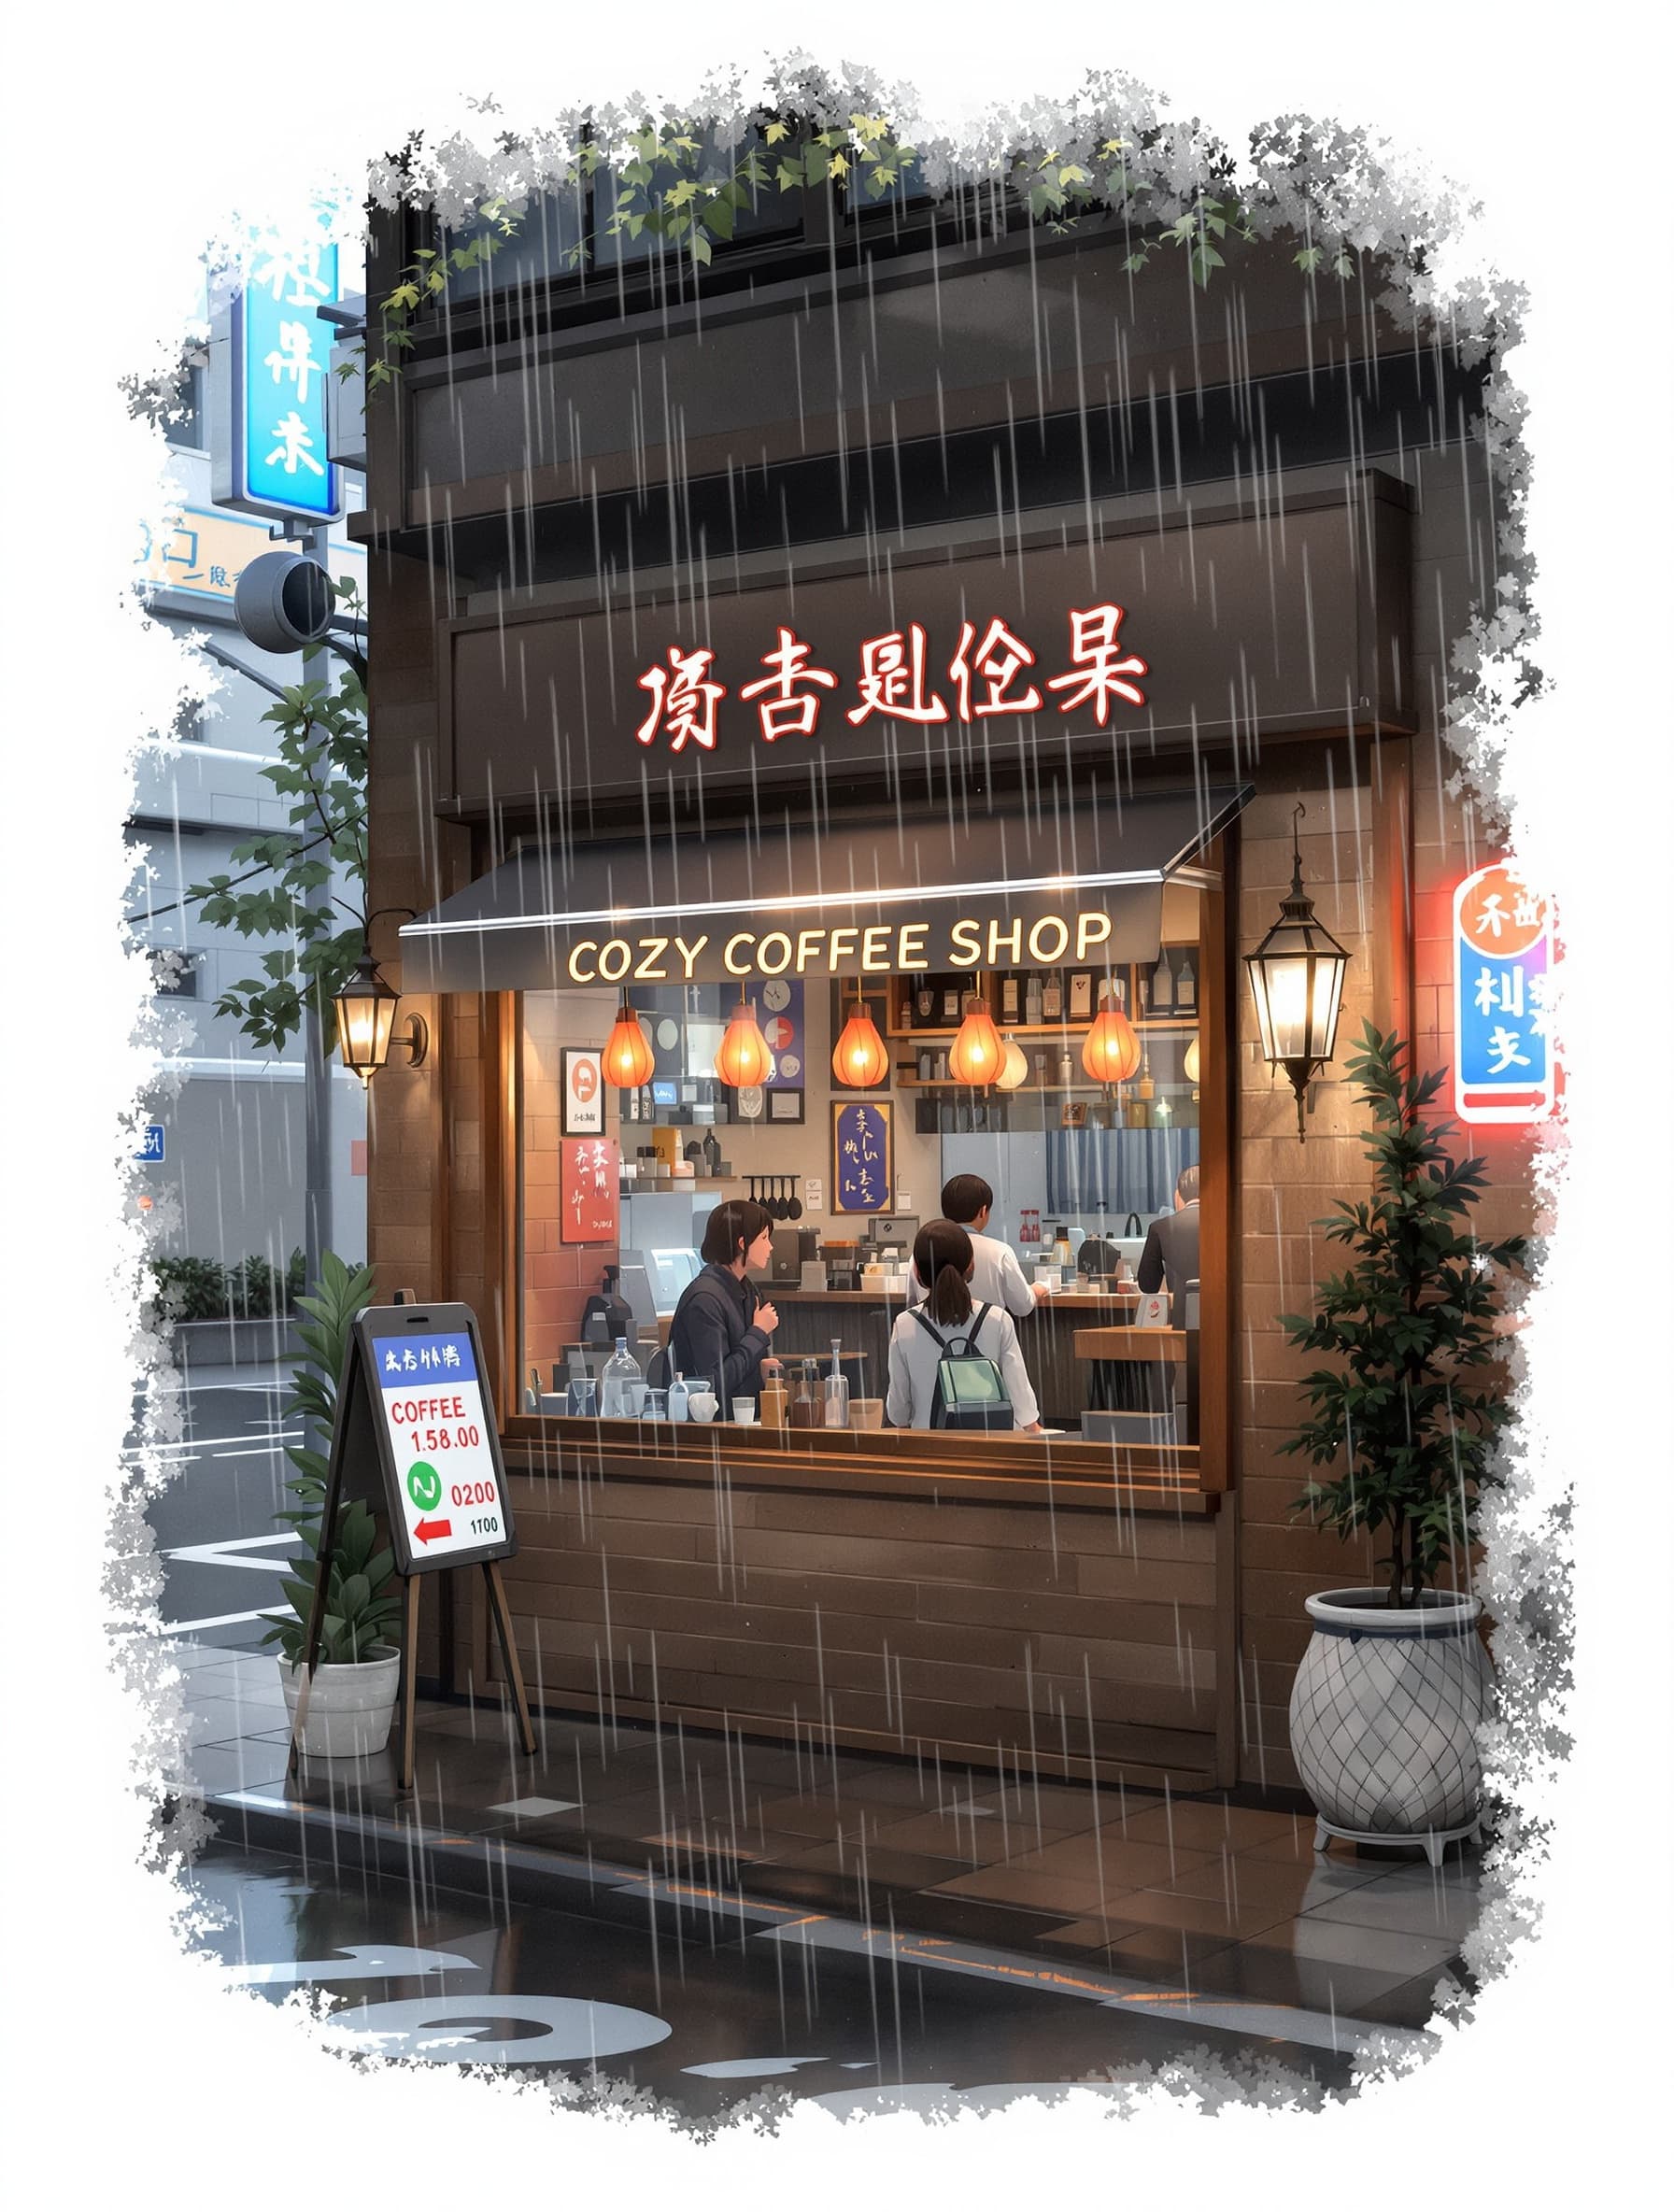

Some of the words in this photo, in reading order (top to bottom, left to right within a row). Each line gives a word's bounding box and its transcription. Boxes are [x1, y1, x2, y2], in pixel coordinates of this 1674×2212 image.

[568, 936, 708, 984] COZY
[723, 924, 930, 975] COFFEE
[948, 912, 1113, 966] SHOP
[391, 1397, 466, 1425] COFFEE
[411, 1425, 480, 1452] 1.58.00
[450, 1482, 496, 1507] 0200
